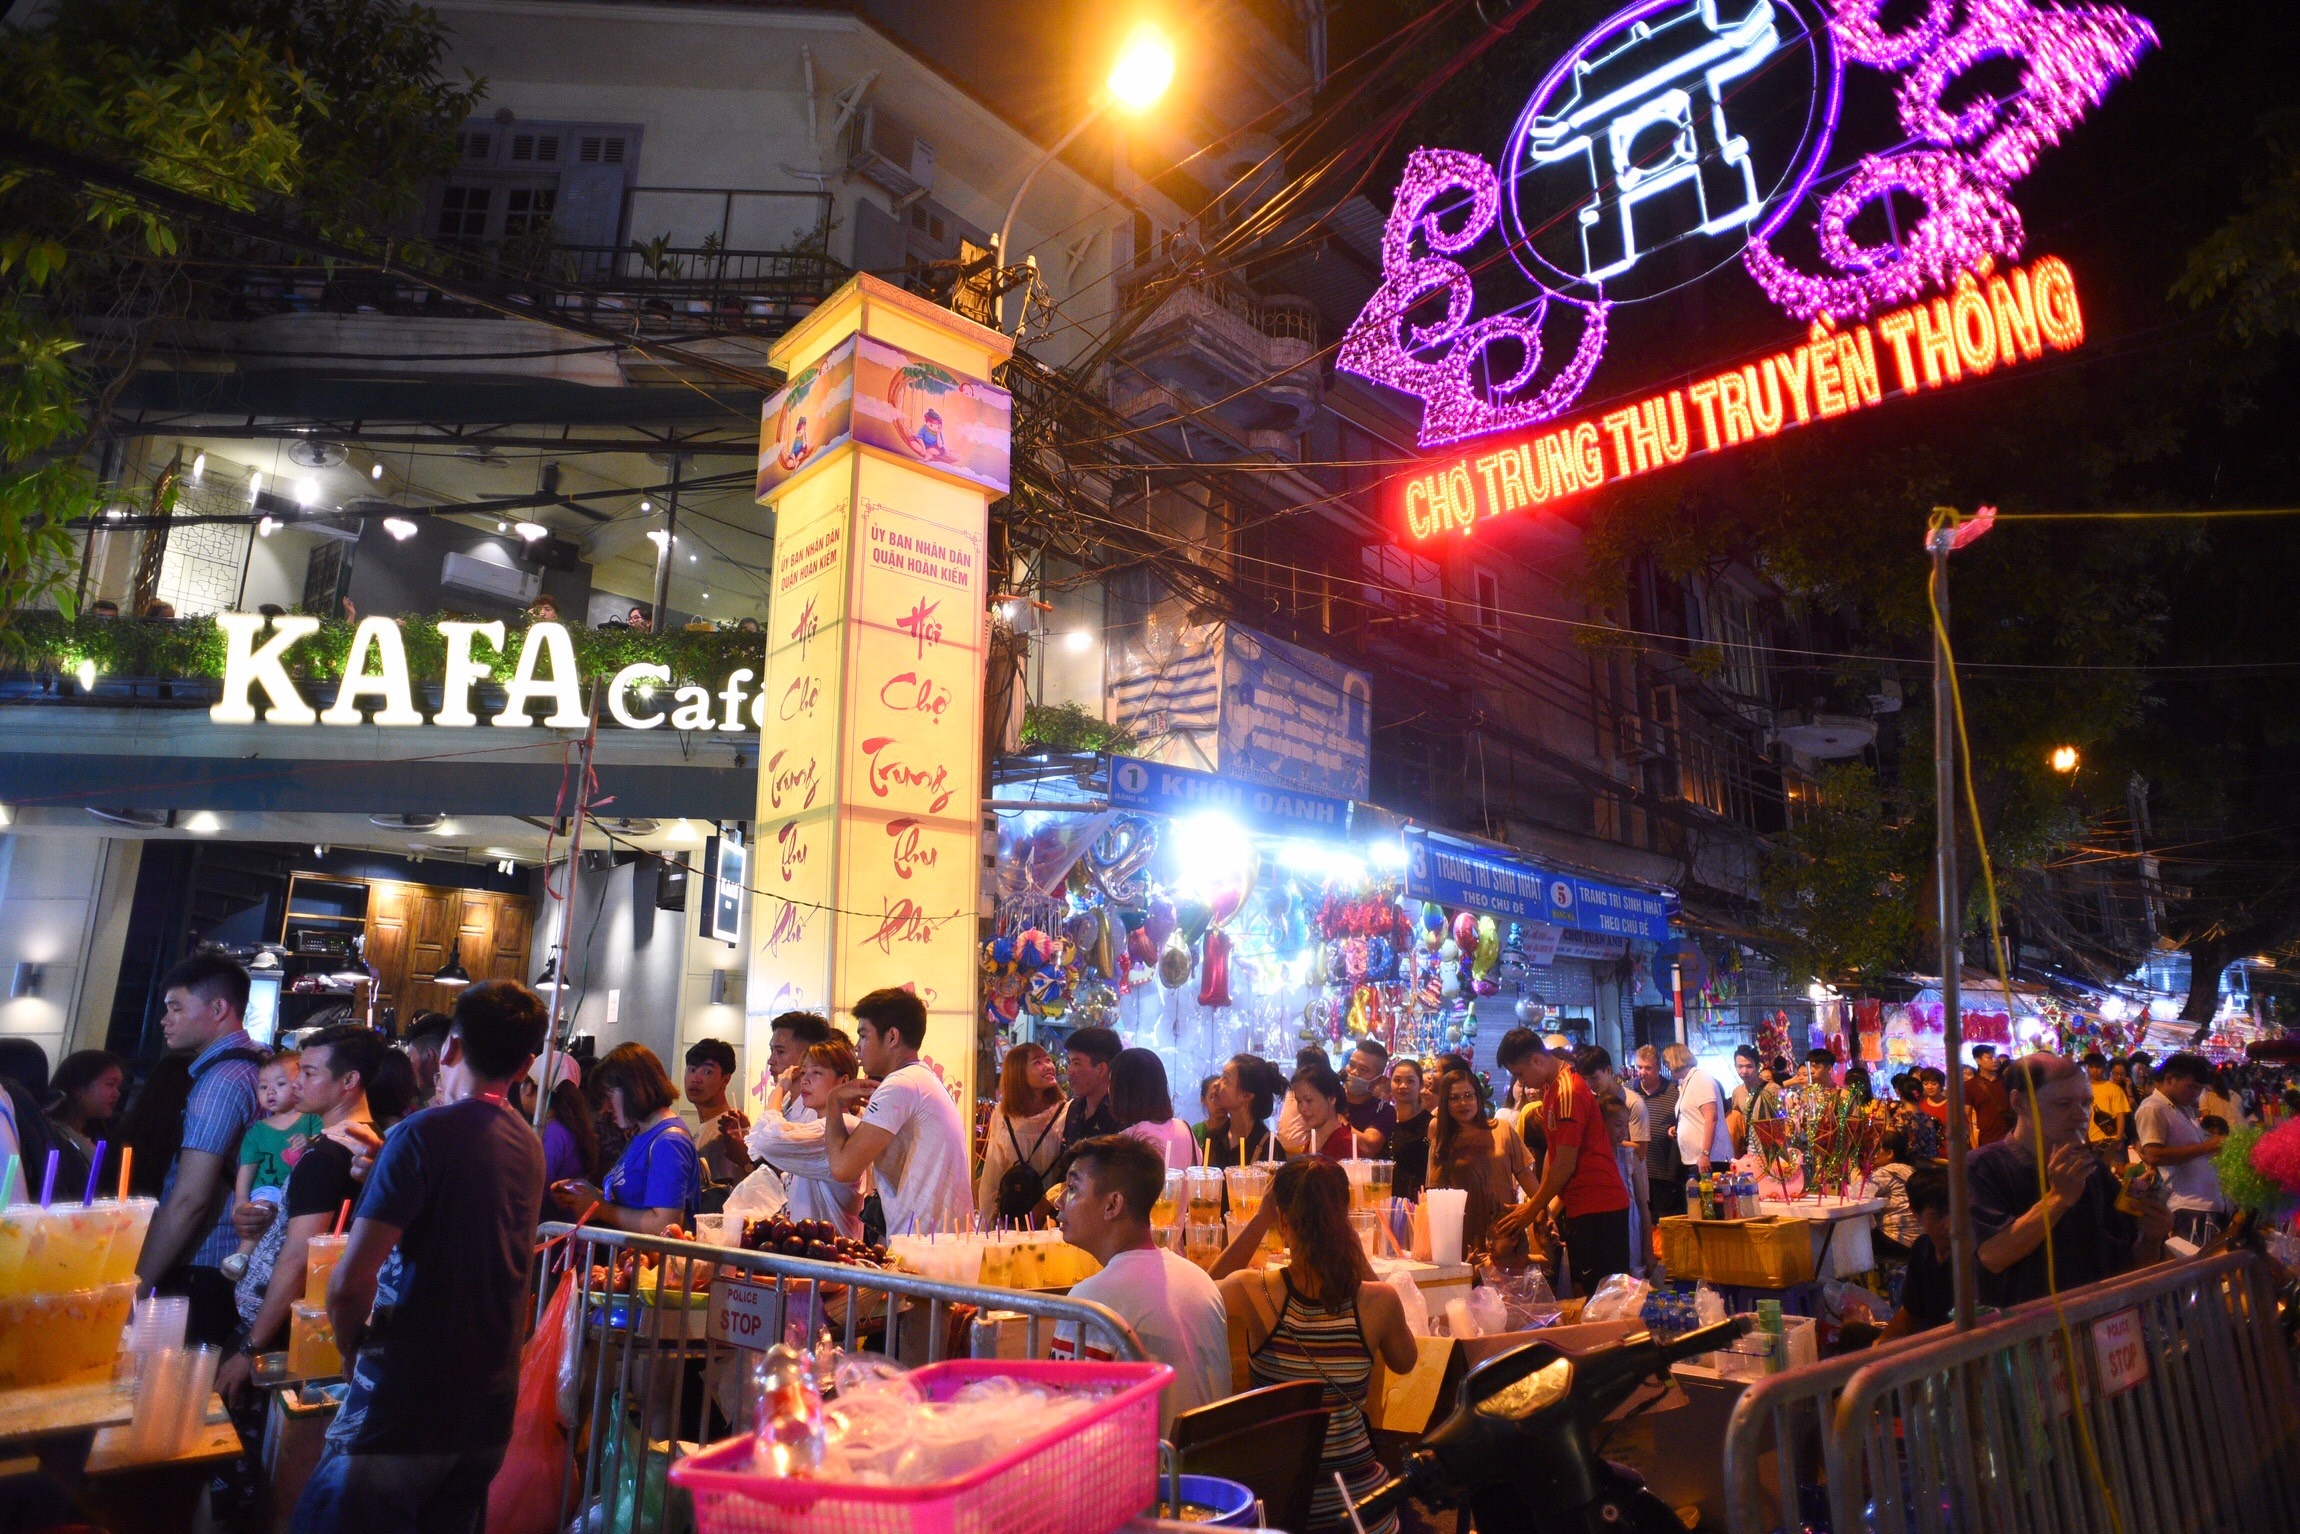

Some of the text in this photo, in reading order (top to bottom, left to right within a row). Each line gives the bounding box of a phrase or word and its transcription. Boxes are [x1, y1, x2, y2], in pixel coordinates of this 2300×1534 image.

[1404, 251, 2083, 538] CHỢ TRUNG THU TRUYỀN THỐNG
[791, 548, 804, 567] BAN
[871, 522, 971, 568] ỦY BAN NHÂN DÂN
[873, 547, 968, 587] QUẬN HOÀN KIẾM
[209, 613, 592, 728] KAFA
[779, 675, 822, 721] Chợ
[880, 671, 952, 725] Chợ
[768, 749, 825, 810] Trung
[862, 736, 964, 814] Trung
[1126, 767, 1139, 789] 1
[1254, 791, 1335, 824] OANH
[778, 819, 808, 883] Thu
[886, 817, 938, 880] Thu
[1411, 841, 1542, 905] 3 TRANG TRÍ SINH NHẬT
[1463, 890, 1489, 907] THEO
[1557, 885, 1662, 918] 5 TRANG TRÍ SINH NHẬT
[1600, 914, 1620, 931] THEO
[858, 895, 961, 955] Phố
[727, 1288, 758, 1305] POLICE
[720, 1308, 762, 1336] STOP
[2108, 1342, 2138, 1378] STOP
